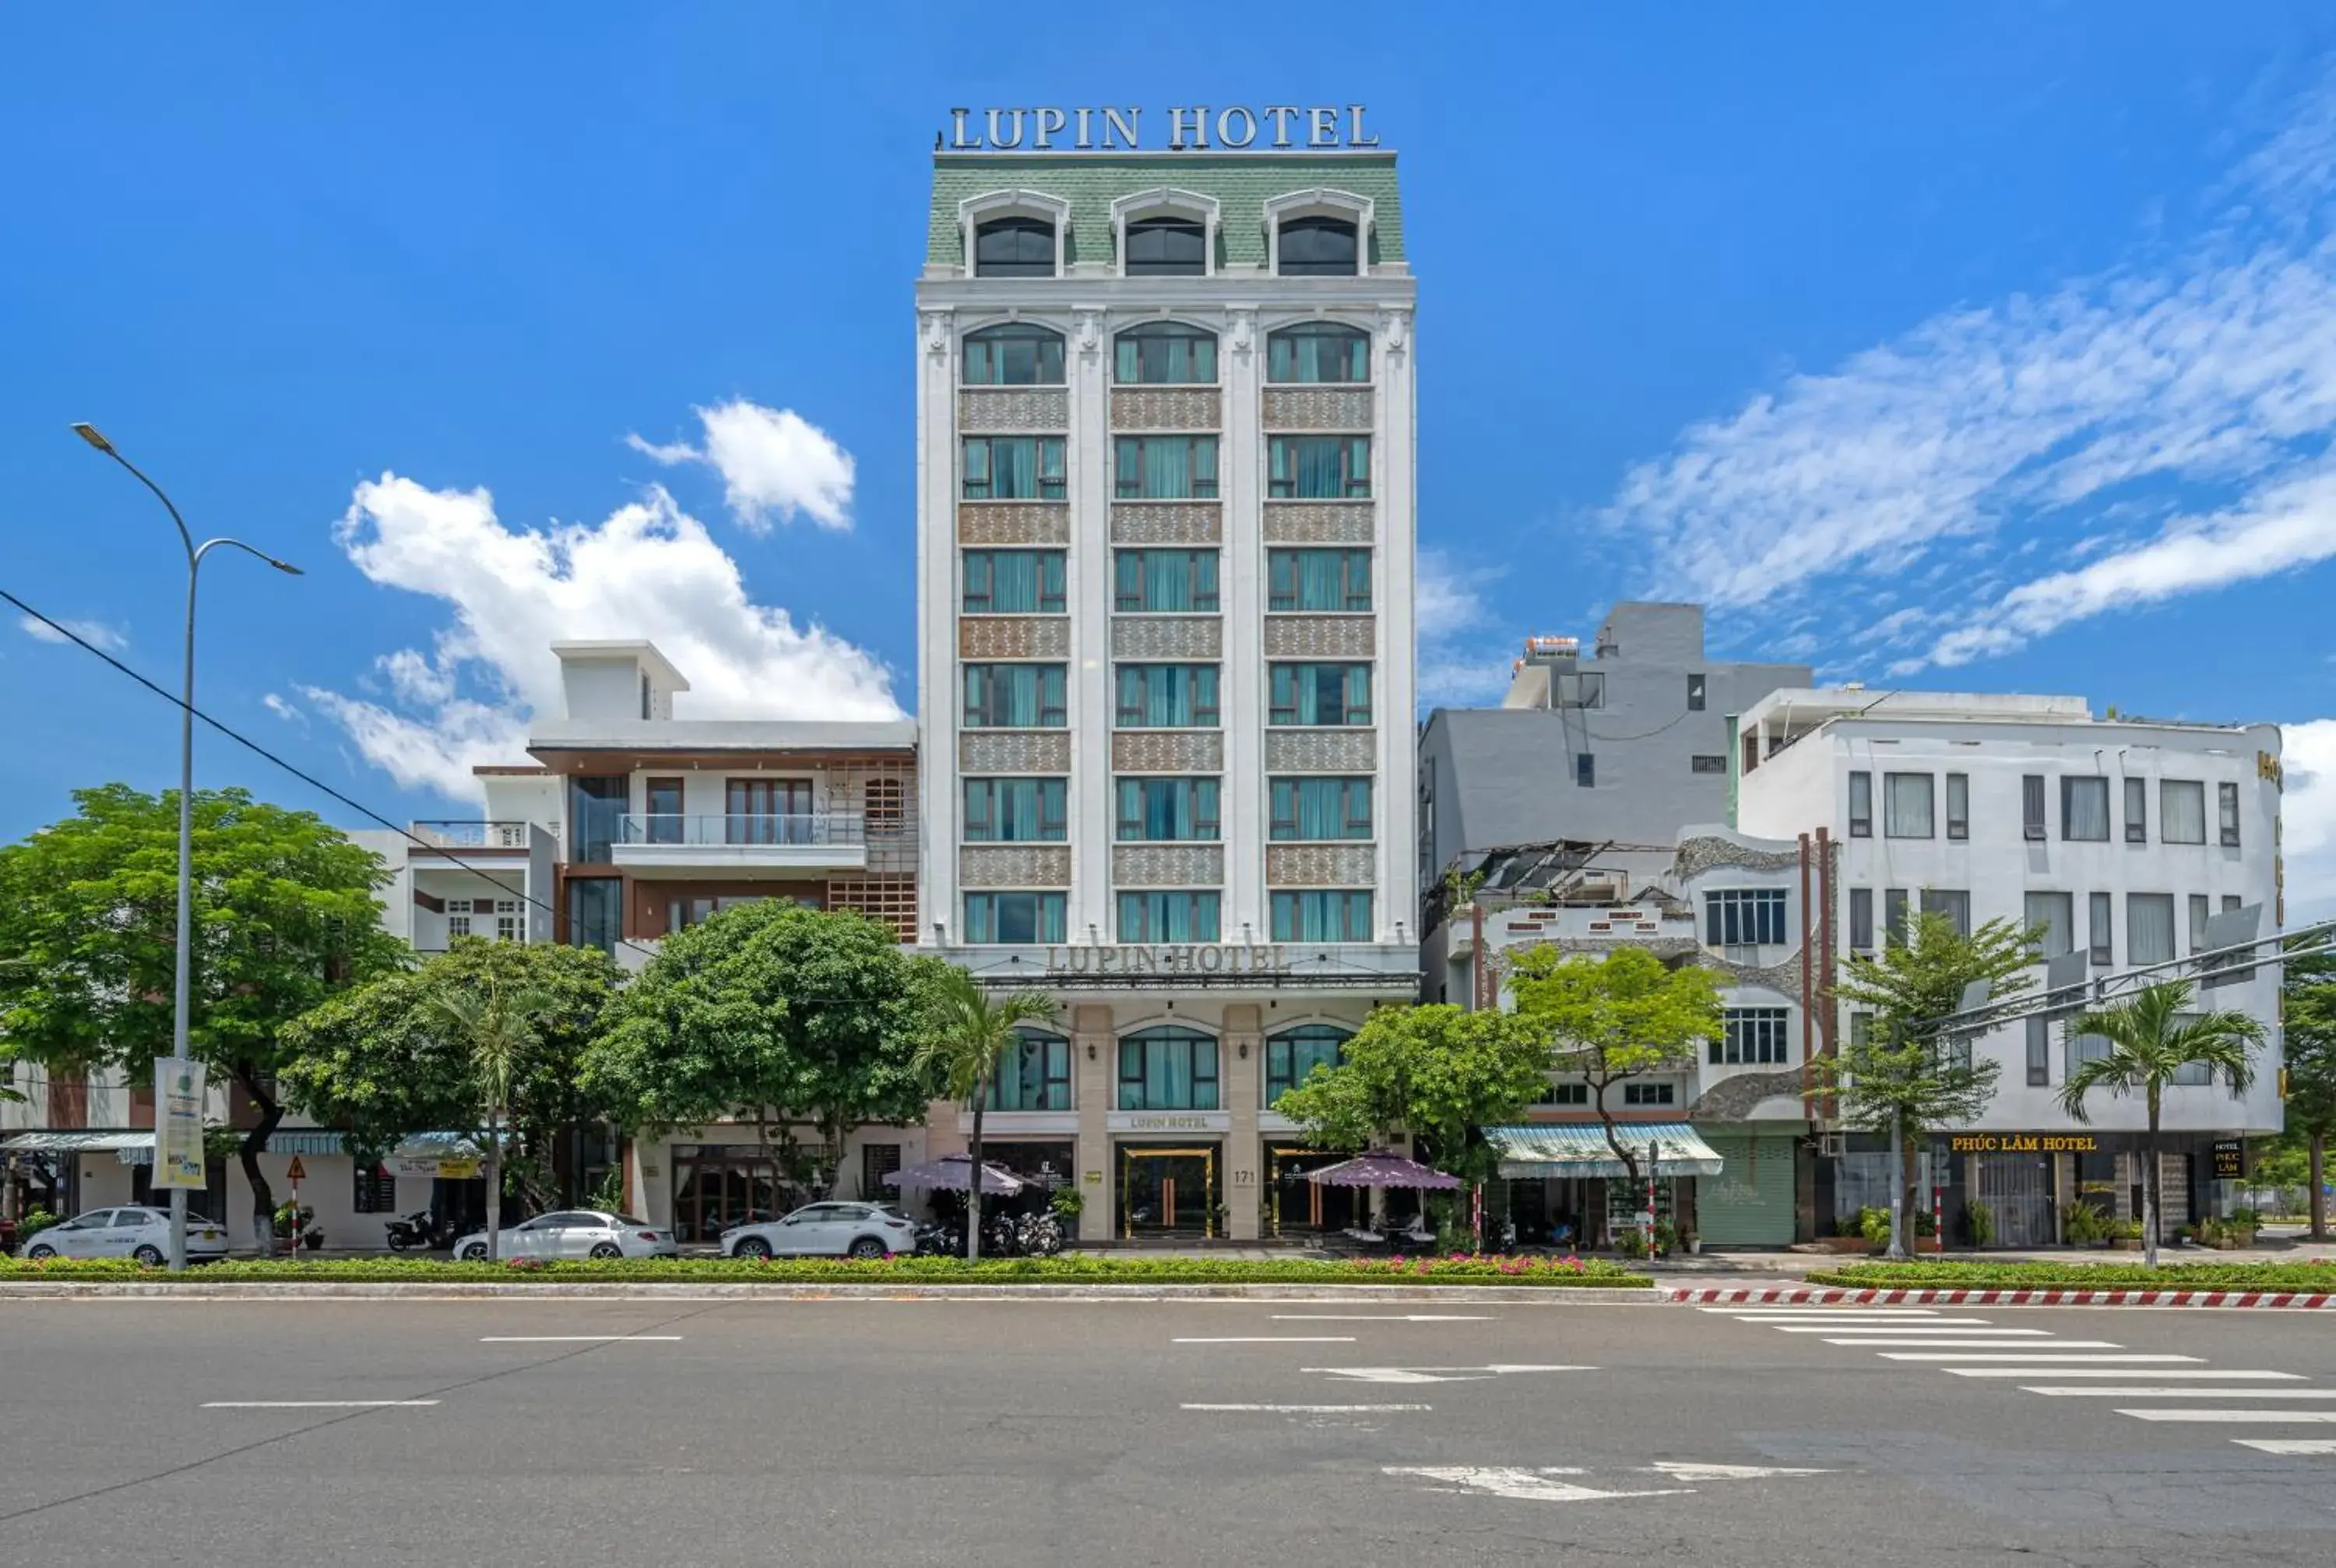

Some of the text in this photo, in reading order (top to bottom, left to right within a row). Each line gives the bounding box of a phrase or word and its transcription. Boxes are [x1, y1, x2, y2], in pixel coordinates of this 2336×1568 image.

[950, 104, 1380, 149] LUPIN HOTEL
[1046, 944, 1290, 972] LUPIN HOTEL
[1131, 1116, 1208, 1128] LUPIN HOTEL
[1952, 1133, 2098, 1151] PHÚC LÂM HOTEL
[1233, 1170, 1255, 1184] 171
